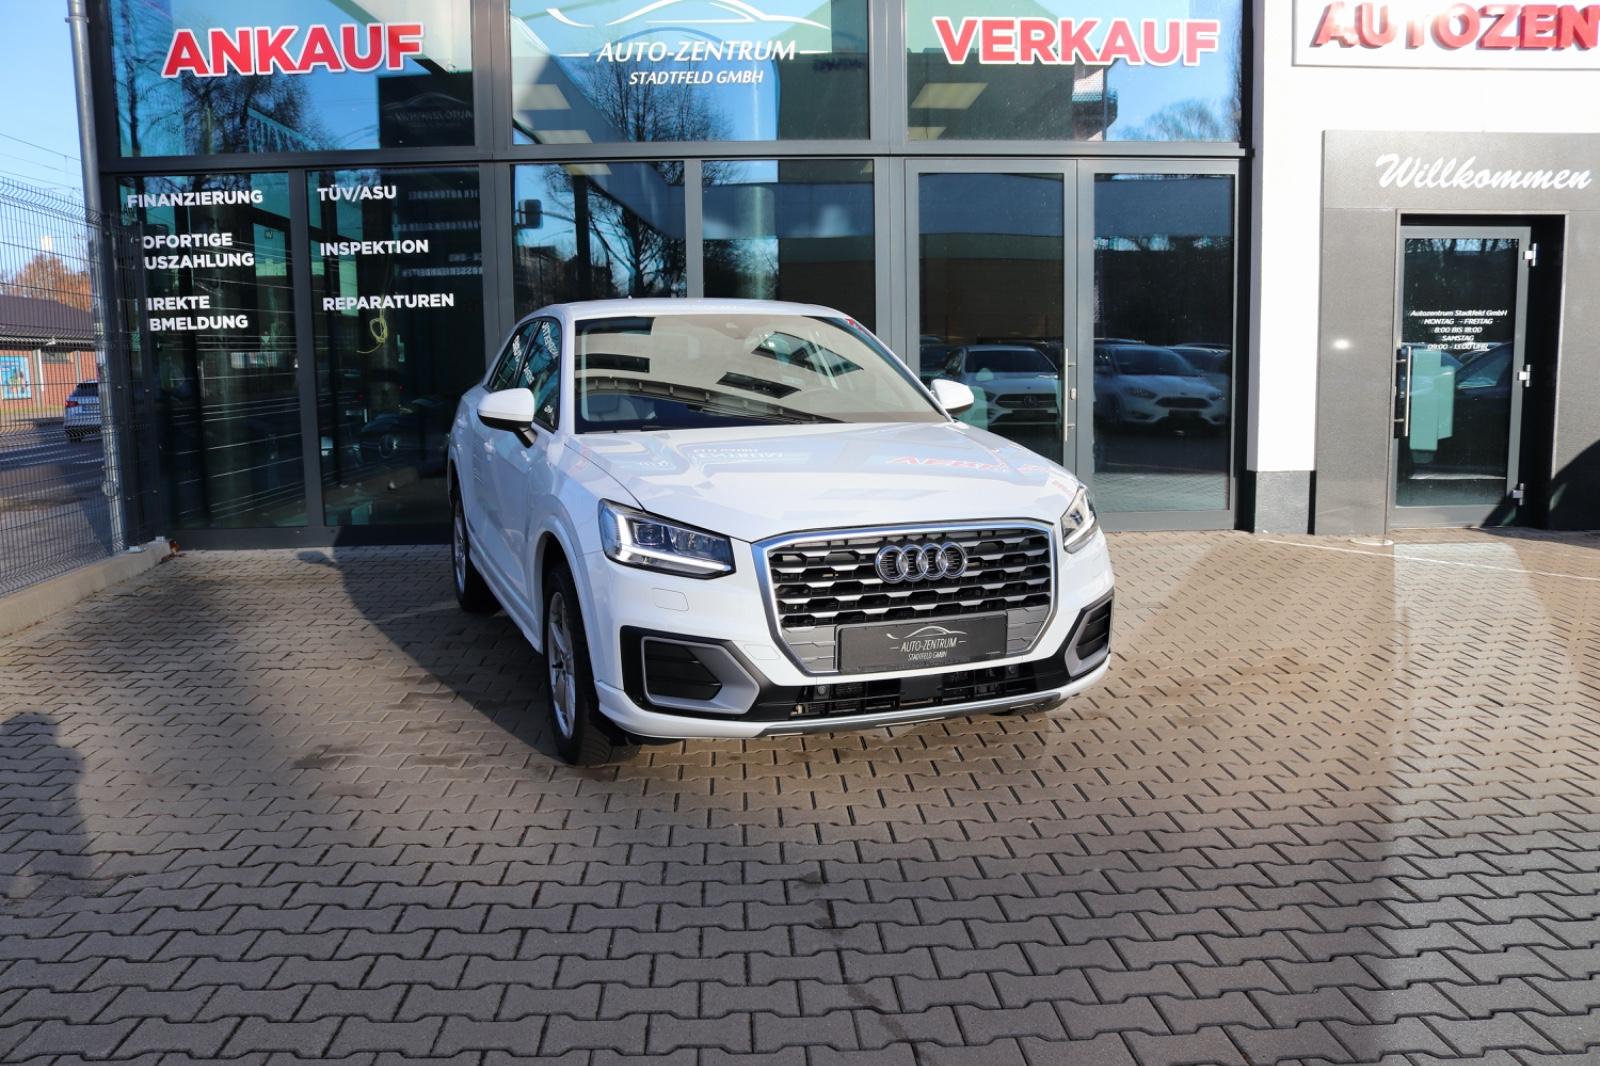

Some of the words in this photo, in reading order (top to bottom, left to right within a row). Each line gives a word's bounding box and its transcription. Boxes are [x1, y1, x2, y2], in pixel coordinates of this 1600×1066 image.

[932, 16, 1220, 66] VERKAUF
[161, 23, 425, 78] ANKAUF
[596, 40, 796, 63] AUTO-ZENTRUM
[629, 71, 713, 85] STADTFELD
[717, 70, 764, 84] GMBH
[1375, 153, 1592, 190] Willkommen
[127, 190, 263, 208] FINANZIERUNG
[317, 184, 397, 202] TÜV/ASU
[142, 232, 233, 249] OFORTIGE
[320, 239, 429, 257] INSPEKTION
[144, 252, 255, 270] USZAHLUNG
[146, 295, 211, 311] IREKTE
[322, 293, 455, 311] REPARATUREN
[149, 314, 249, 332] BMELDUNG
[1451, 326, 1463, 334] BIS
[901, 637, 957, 652] AUTO-ZENTRUM
